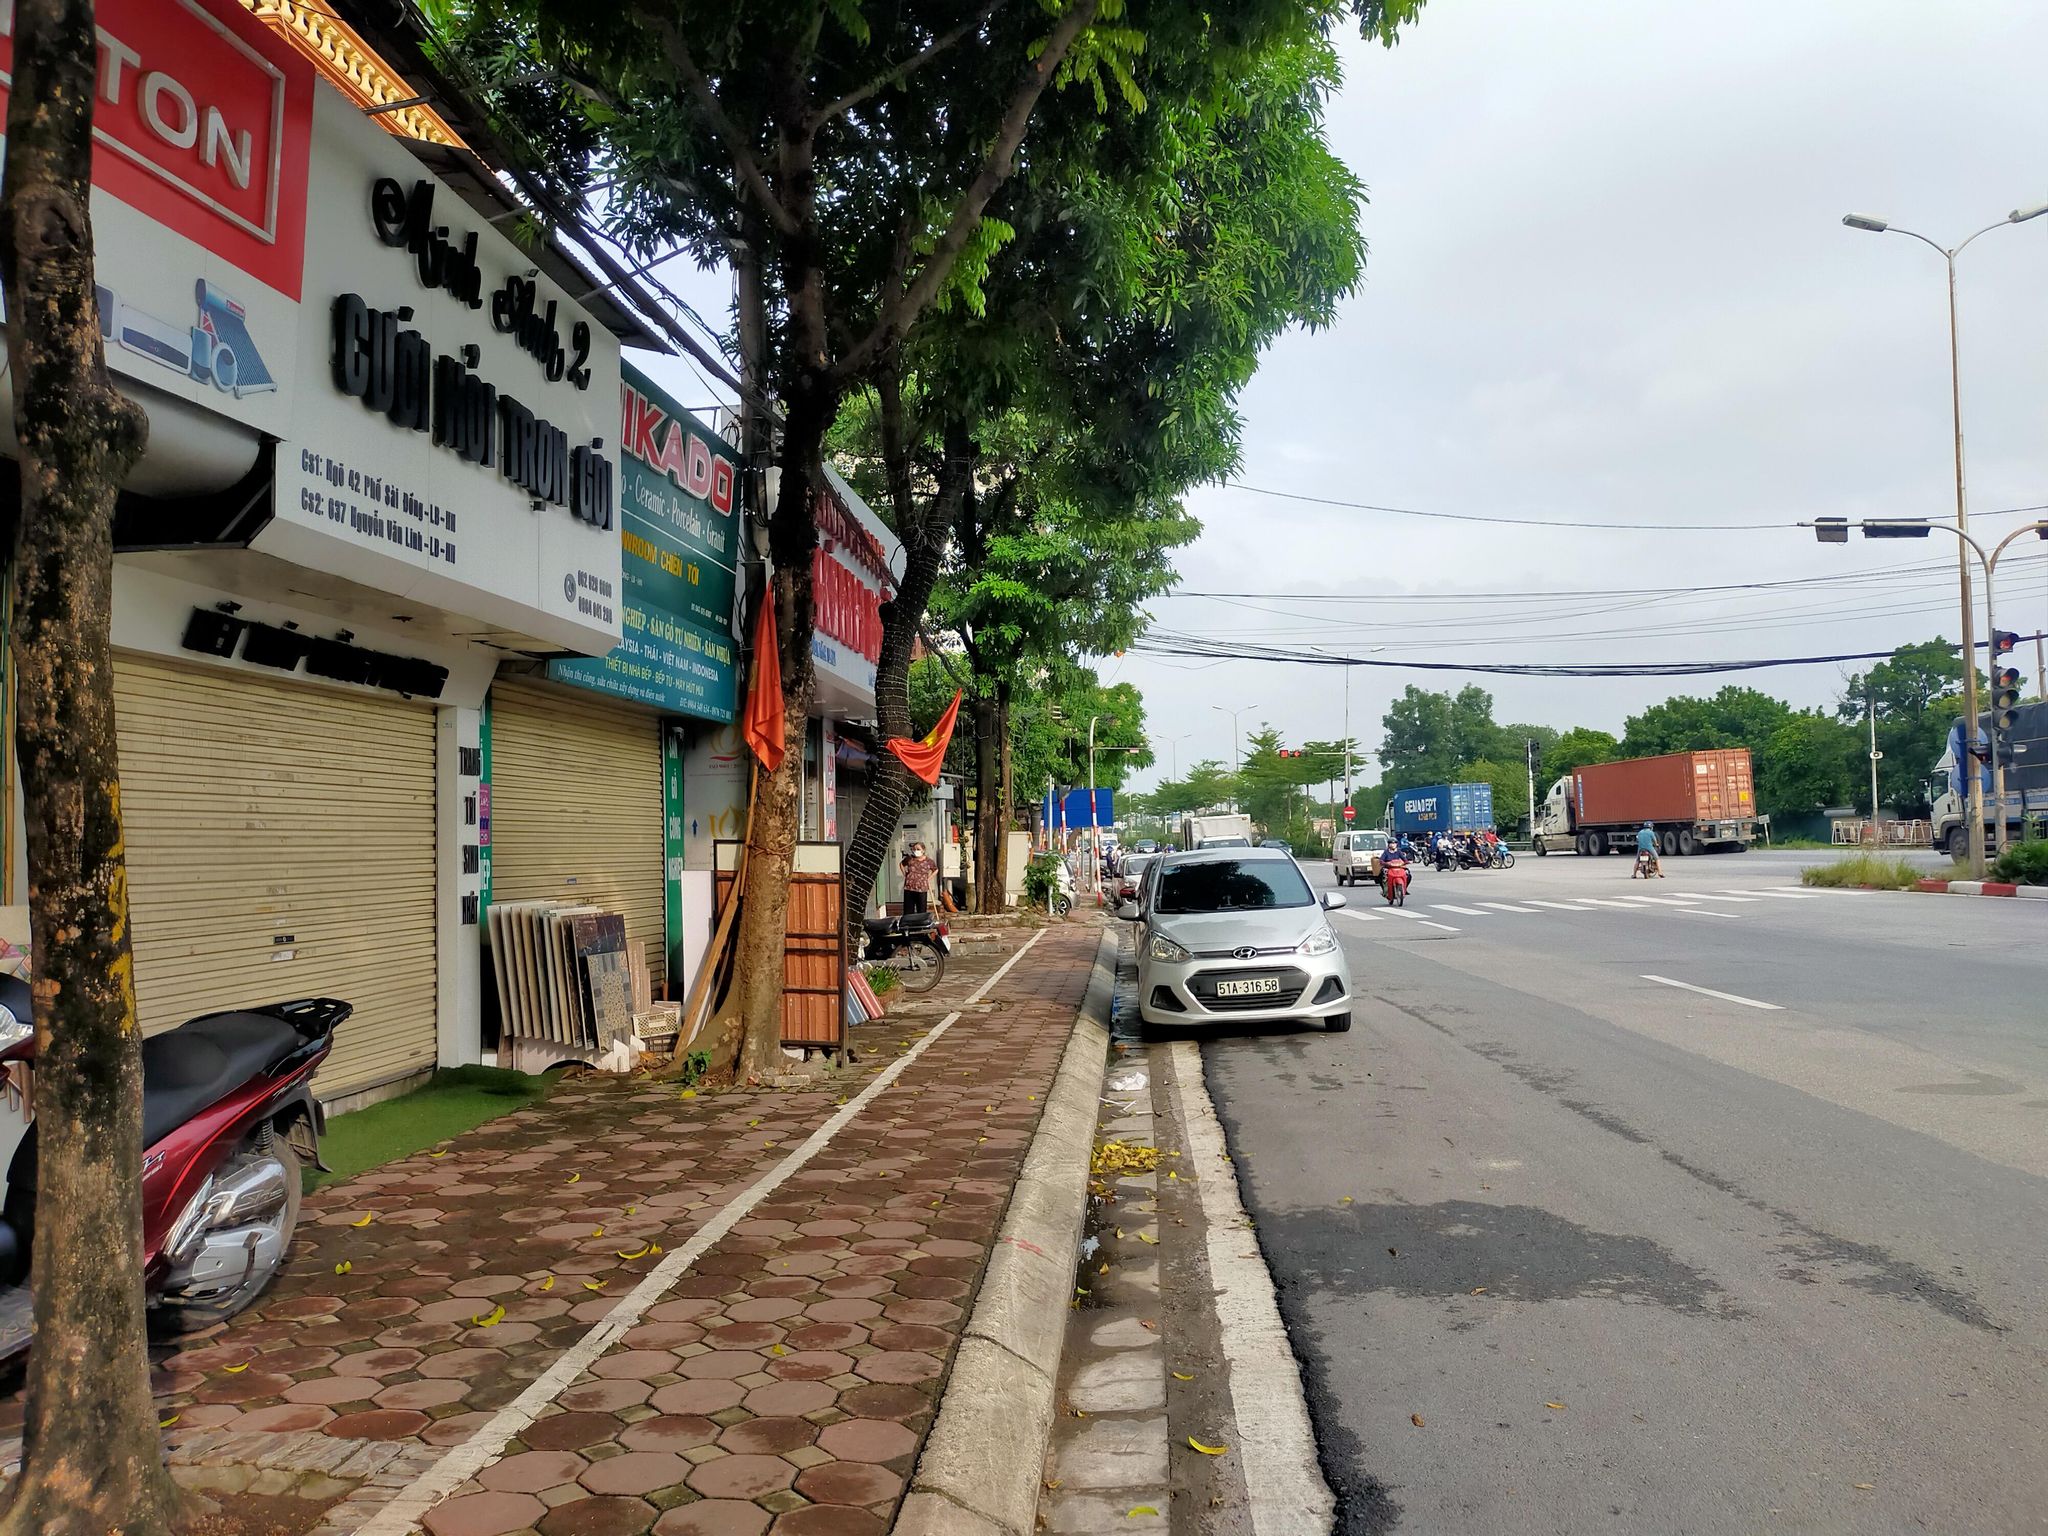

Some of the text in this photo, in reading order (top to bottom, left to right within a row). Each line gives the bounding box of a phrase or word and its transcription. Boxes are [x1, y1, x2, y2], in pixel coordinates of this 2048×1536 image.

[567, 321, 592, 391] 2
[301, 448, 323, 477] Cs1:
[348, 469, 361, 494] 42
[620, 378, 735, 518] IKADO
[301, 486, 324, 516] Cs2:
[635, 474, 666, 518] Ceramic
[671, 497, 701, 539] Porcelain
[621, 528, 657, 565] WROOM
[1218, 979, 1278, 995] 51A-316.58
